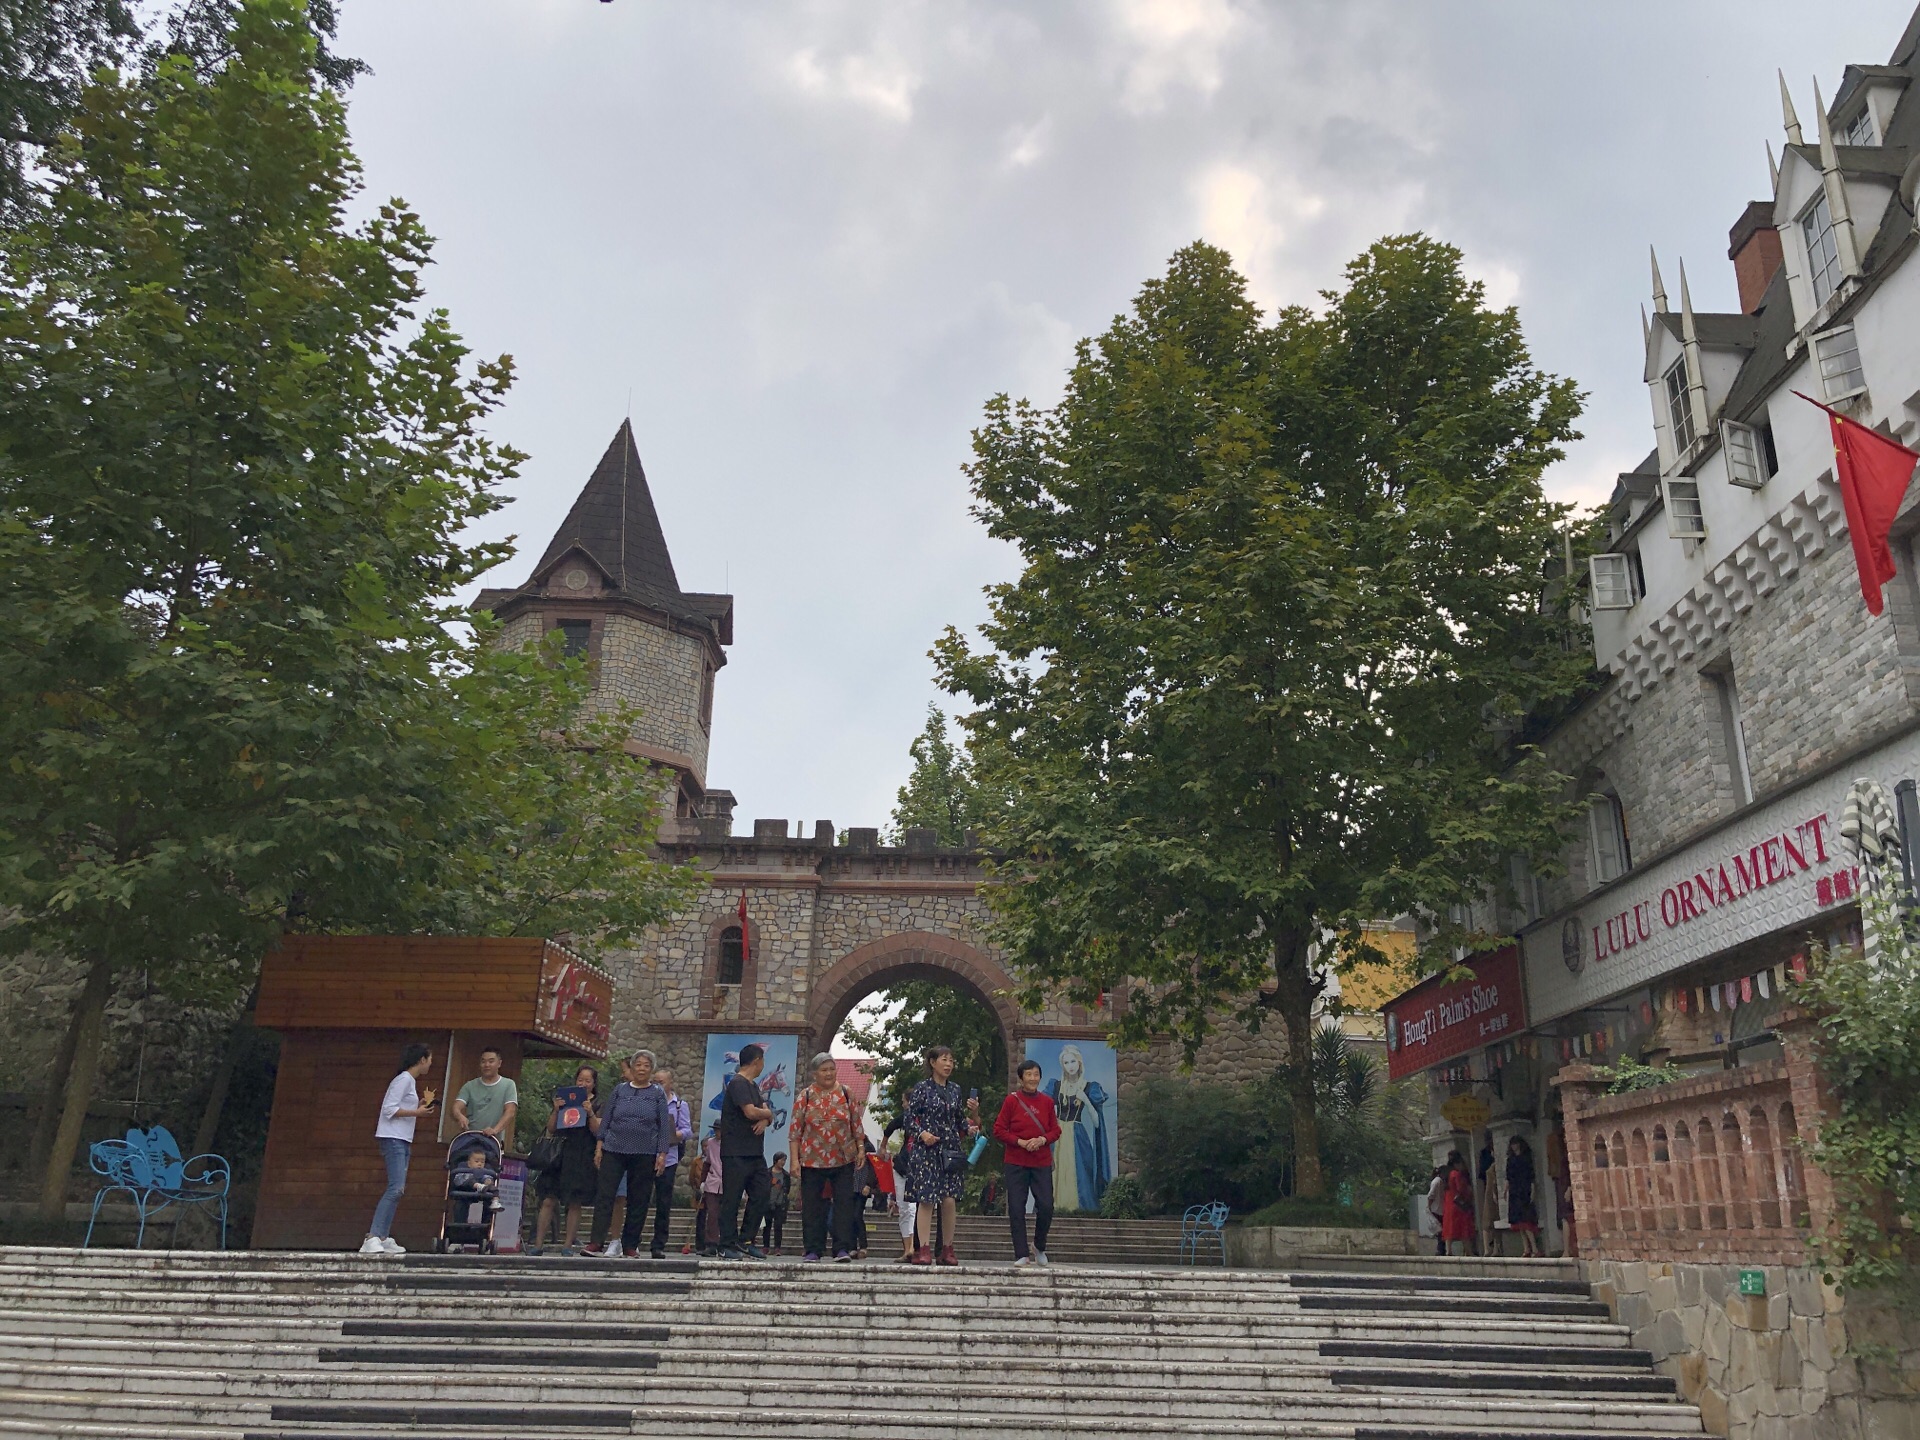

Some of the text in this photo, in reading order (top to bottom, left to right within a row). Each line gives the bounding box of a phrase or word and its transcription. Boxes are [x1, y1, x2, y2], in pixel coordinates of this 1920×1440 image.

[1593, 900, 1651, 961] LULU
[1661, 813, 1830, 928] ORNAMENT
[1404, 1008, 1437, 1047] HongYi
[1439, 994, 1471, 1030] Palm's
[1472, 984, 1499, 1014] Shoe
